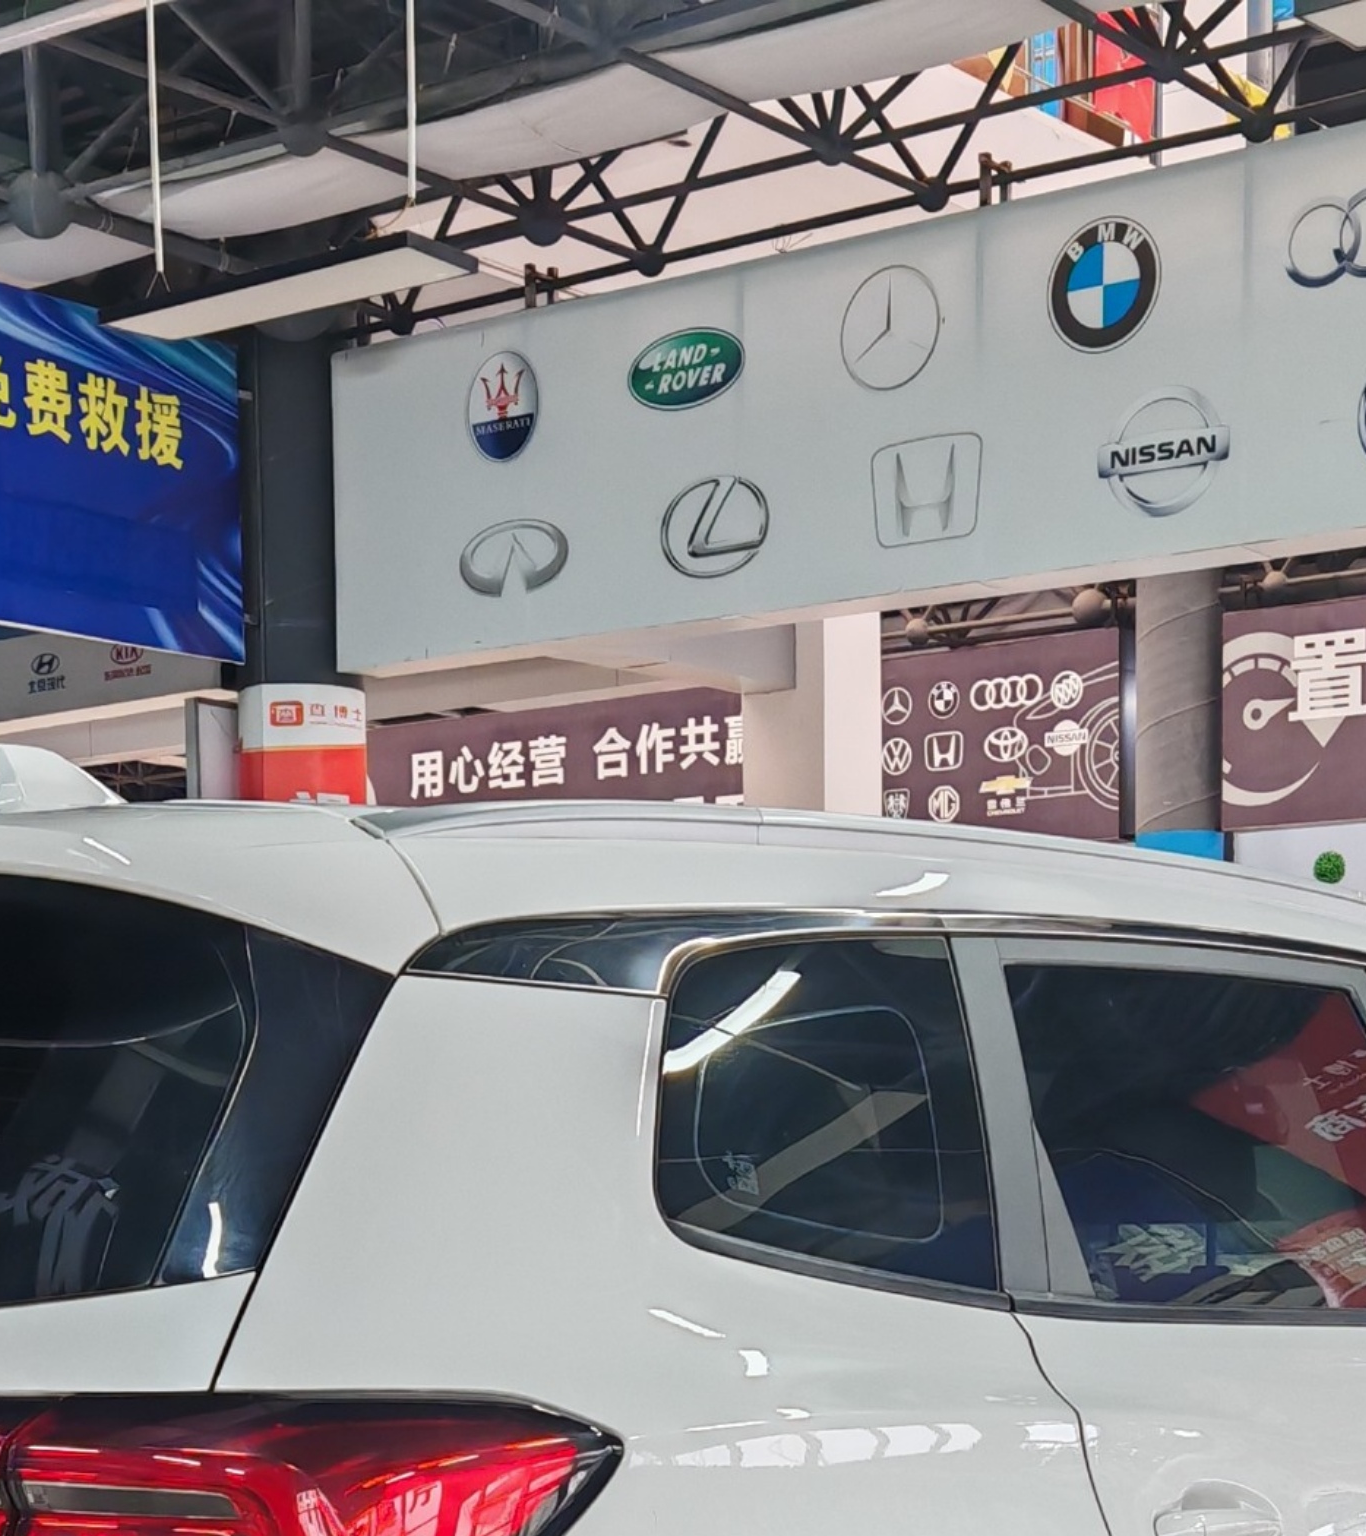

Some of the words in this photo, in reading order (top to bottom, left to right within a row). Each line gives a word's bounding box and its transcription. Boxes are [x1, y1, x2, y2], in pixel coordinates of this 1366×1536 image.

[1065, 221, 1145, 262] BMW
[652, 343, 708, 374] LAND
[656, 363, 727, 395] ROVER
[474, 416, 531, 436] MASERATI
[1110, 434, 1217, 470] NISSAN
[1046, 733, 1087, 745] NISSAN
[410, 734, 567, 800] 用心经营
